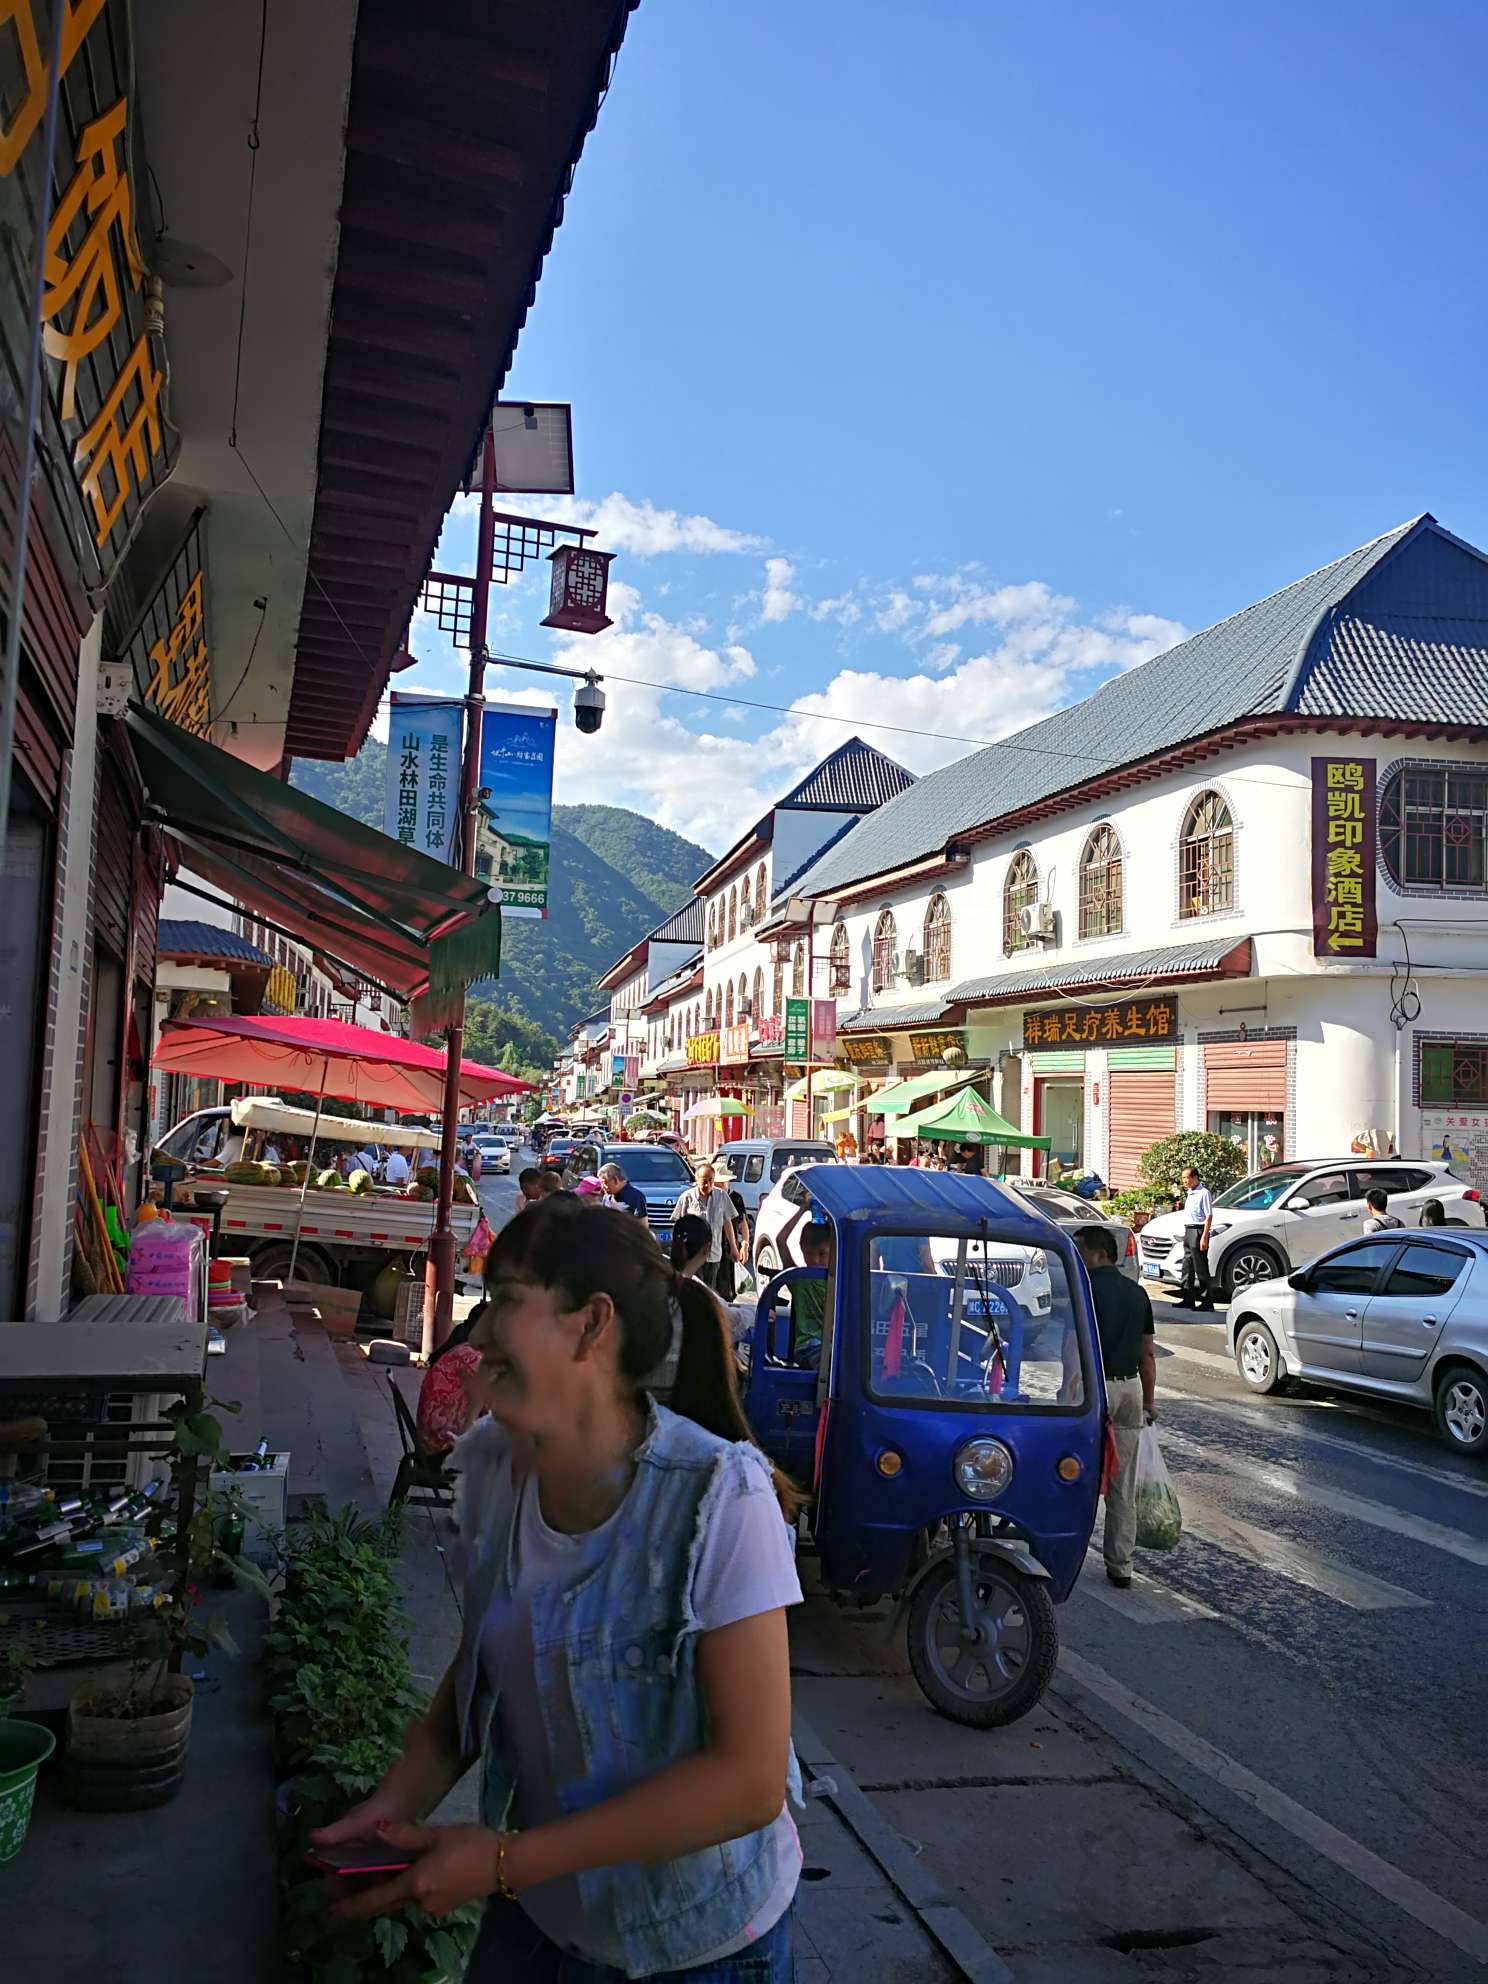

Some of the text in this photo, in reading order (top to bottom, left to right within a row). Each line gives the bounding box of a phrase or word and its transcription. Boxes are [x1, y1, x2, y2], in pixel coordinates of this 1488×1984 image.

[397, 732, 420, 846] 山水林田湖草
[425, 734, 449, 849] 是生命共同体
[517, 892, 545, 904] 9666
[1327, 763, 1365, 932] 鸥凯印象酒店
[1025, 1003, 1170, 1044] 祥瑞足疗养生馆
